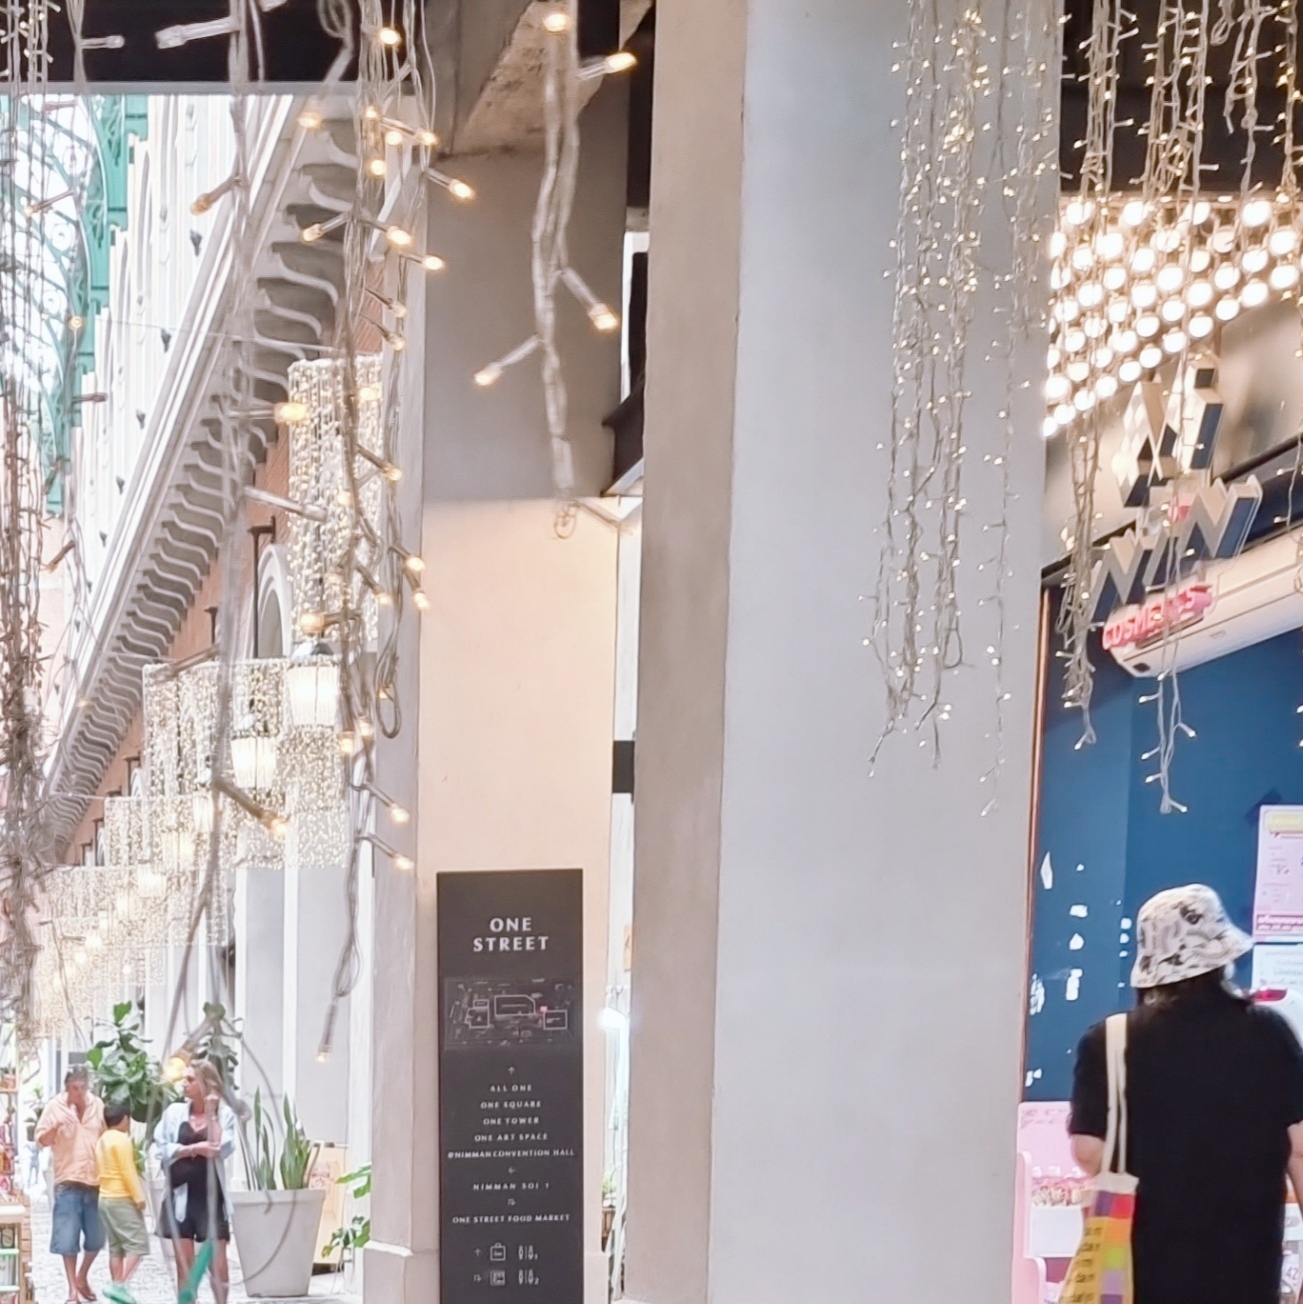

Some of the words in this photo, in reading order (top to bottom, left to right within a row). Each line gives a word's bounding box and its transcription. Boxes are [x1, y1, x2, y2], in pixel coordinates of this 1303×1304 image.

[489, 917, 532, 932] ONE
[473, 936, 549, 952] STREET
[511, 1084, 532, 1092] ONE
[480, 1101, 499, 1109] ONE
[503, 1100, 541, 1109] SQUARE
[483, 1118, 502, 1126] ONE
[505, 1116, 540, 1125] TOWER
[474, 1134, 493, 1142] ONE
[496, 1133, 515, 1141] ART
[519, 1133, 548, 1141] SPACE
[473, 1183, 516, 1191] NIMMAN
[452, 1216, 470, 1224] ONE
[473, 1215, 505, 1223] STREET
[507, 1215, 533, 1223] FOOD
[534, 1213, 571, 1222] MARKET
